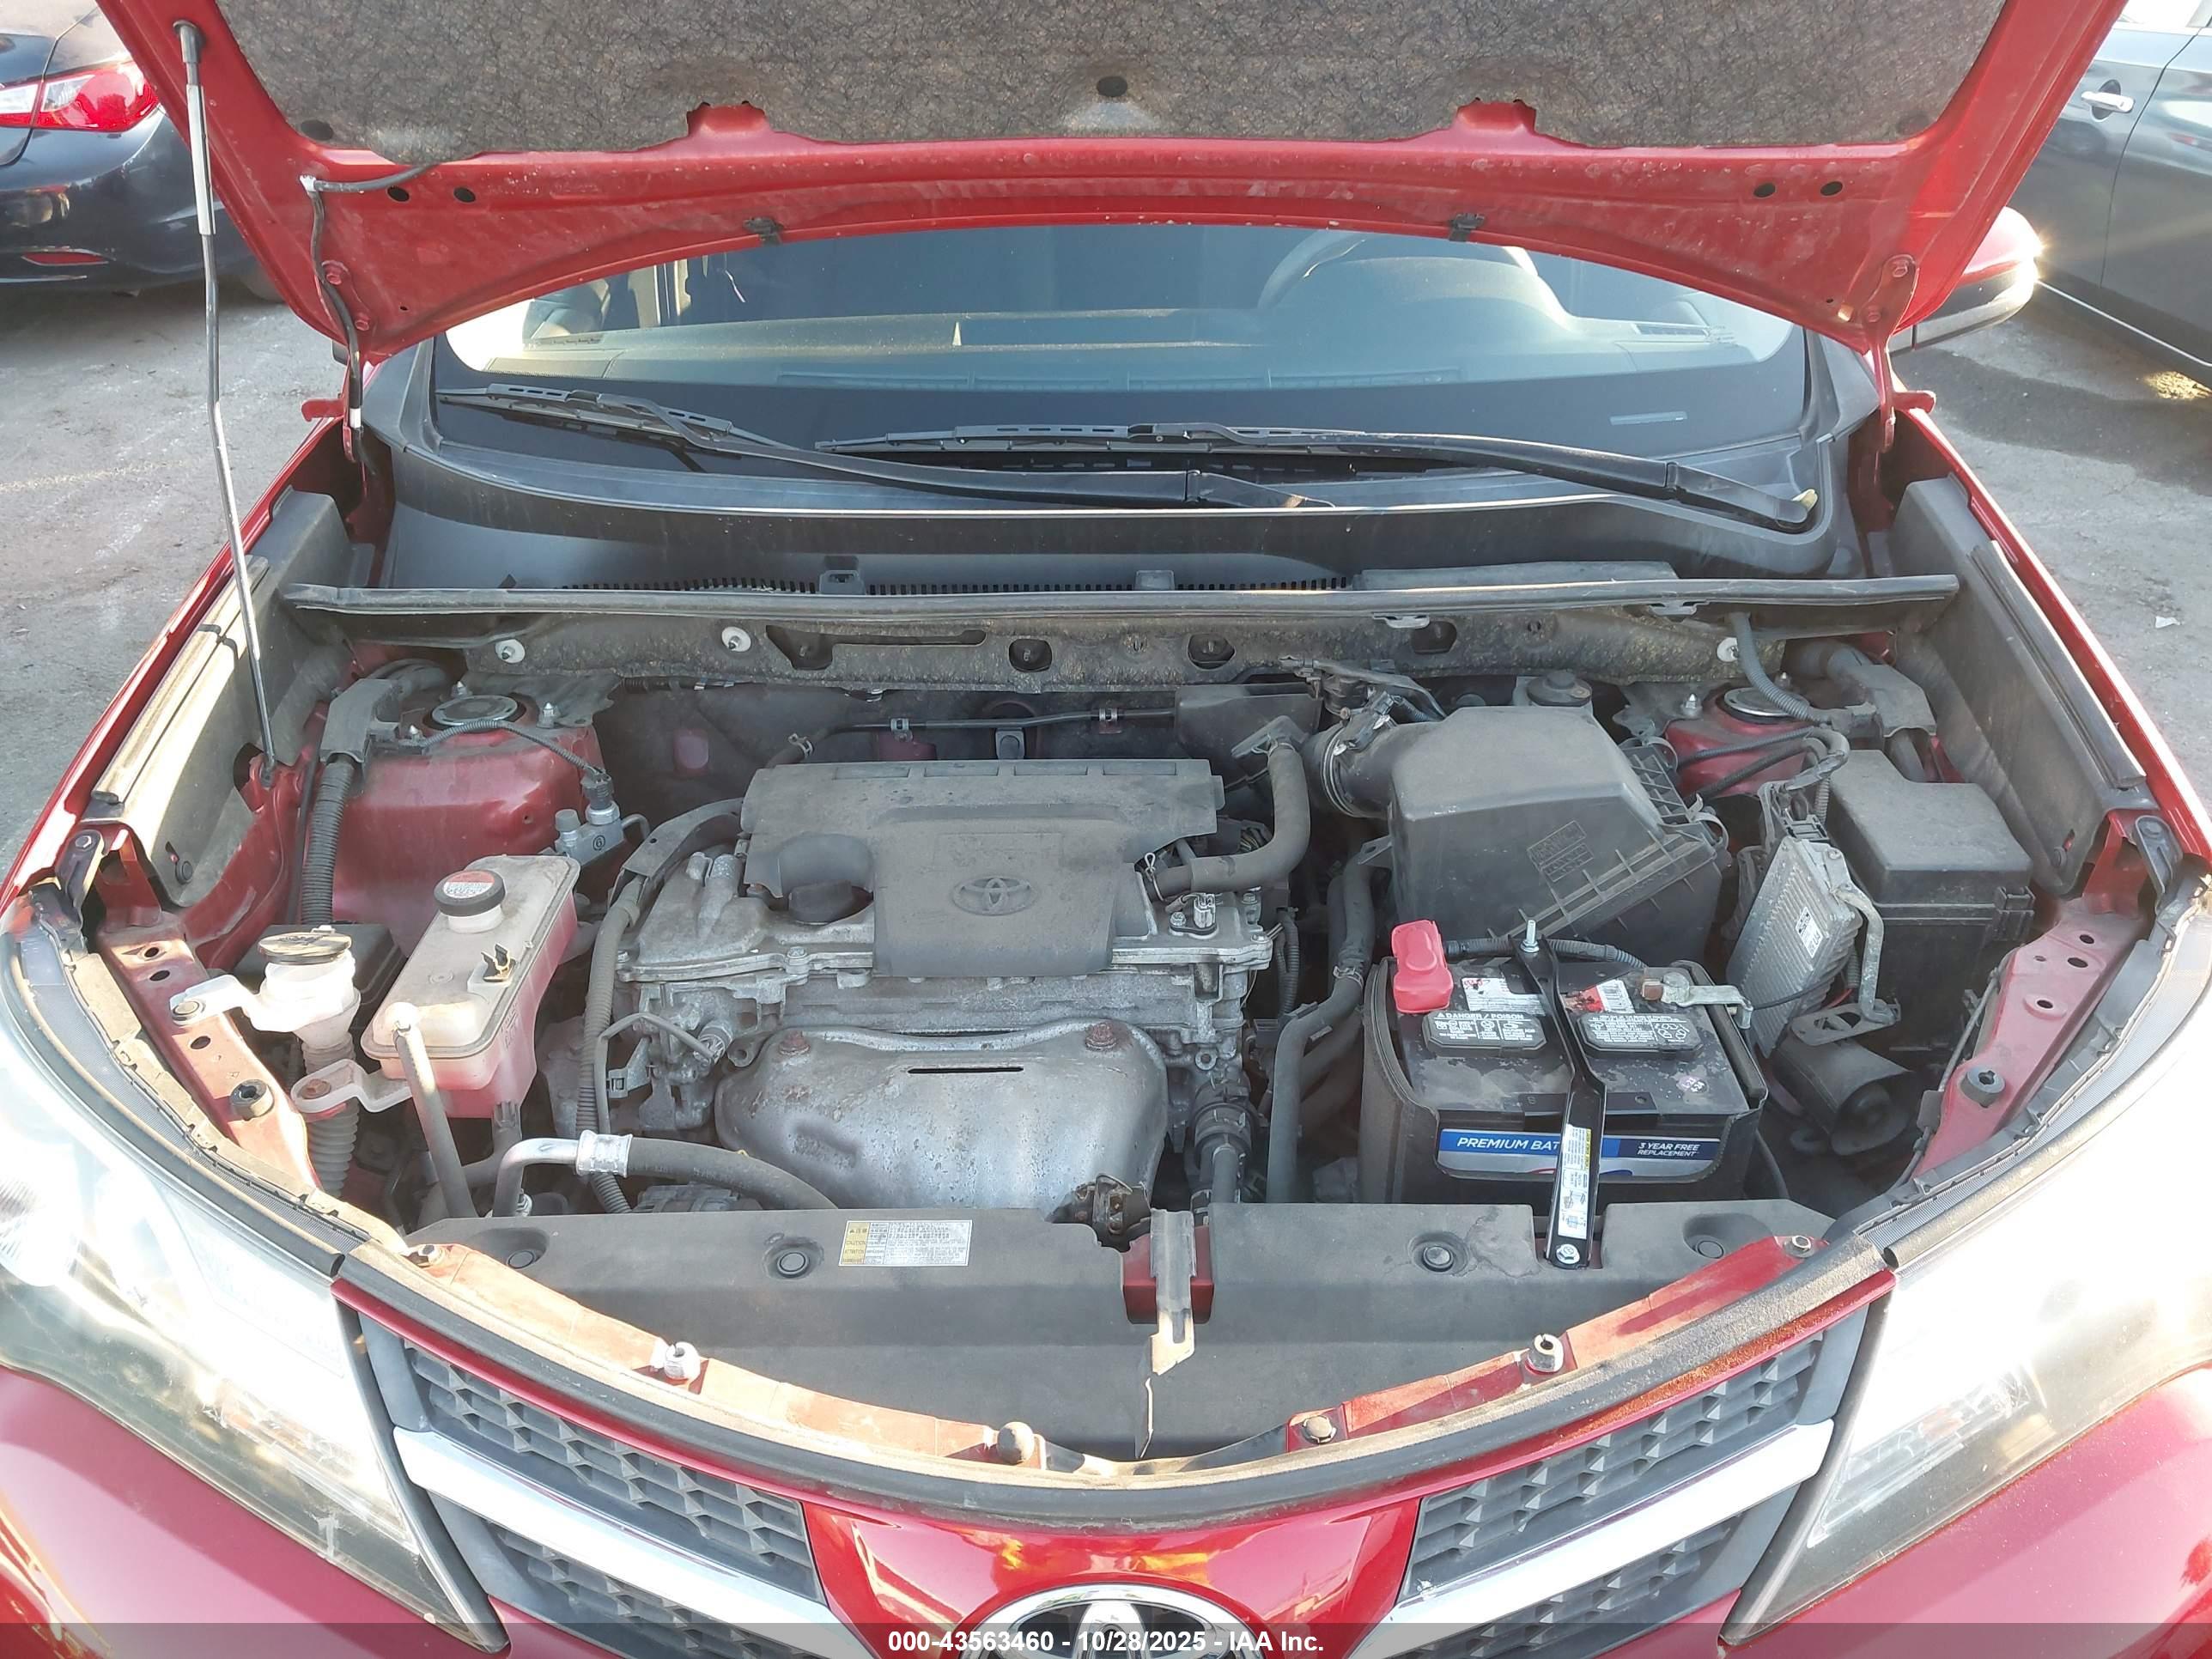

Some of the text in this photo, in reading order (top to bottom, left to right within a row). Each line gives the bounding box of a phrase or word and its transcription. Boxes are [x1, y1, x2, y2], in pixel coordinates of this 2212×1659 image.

[1456, 1137, 1530, 1150] PREMIUM
[1647, 1142, 1674, 1151] YEAR
[1637, 1149, 1698, 1158] REPLACEMENT
